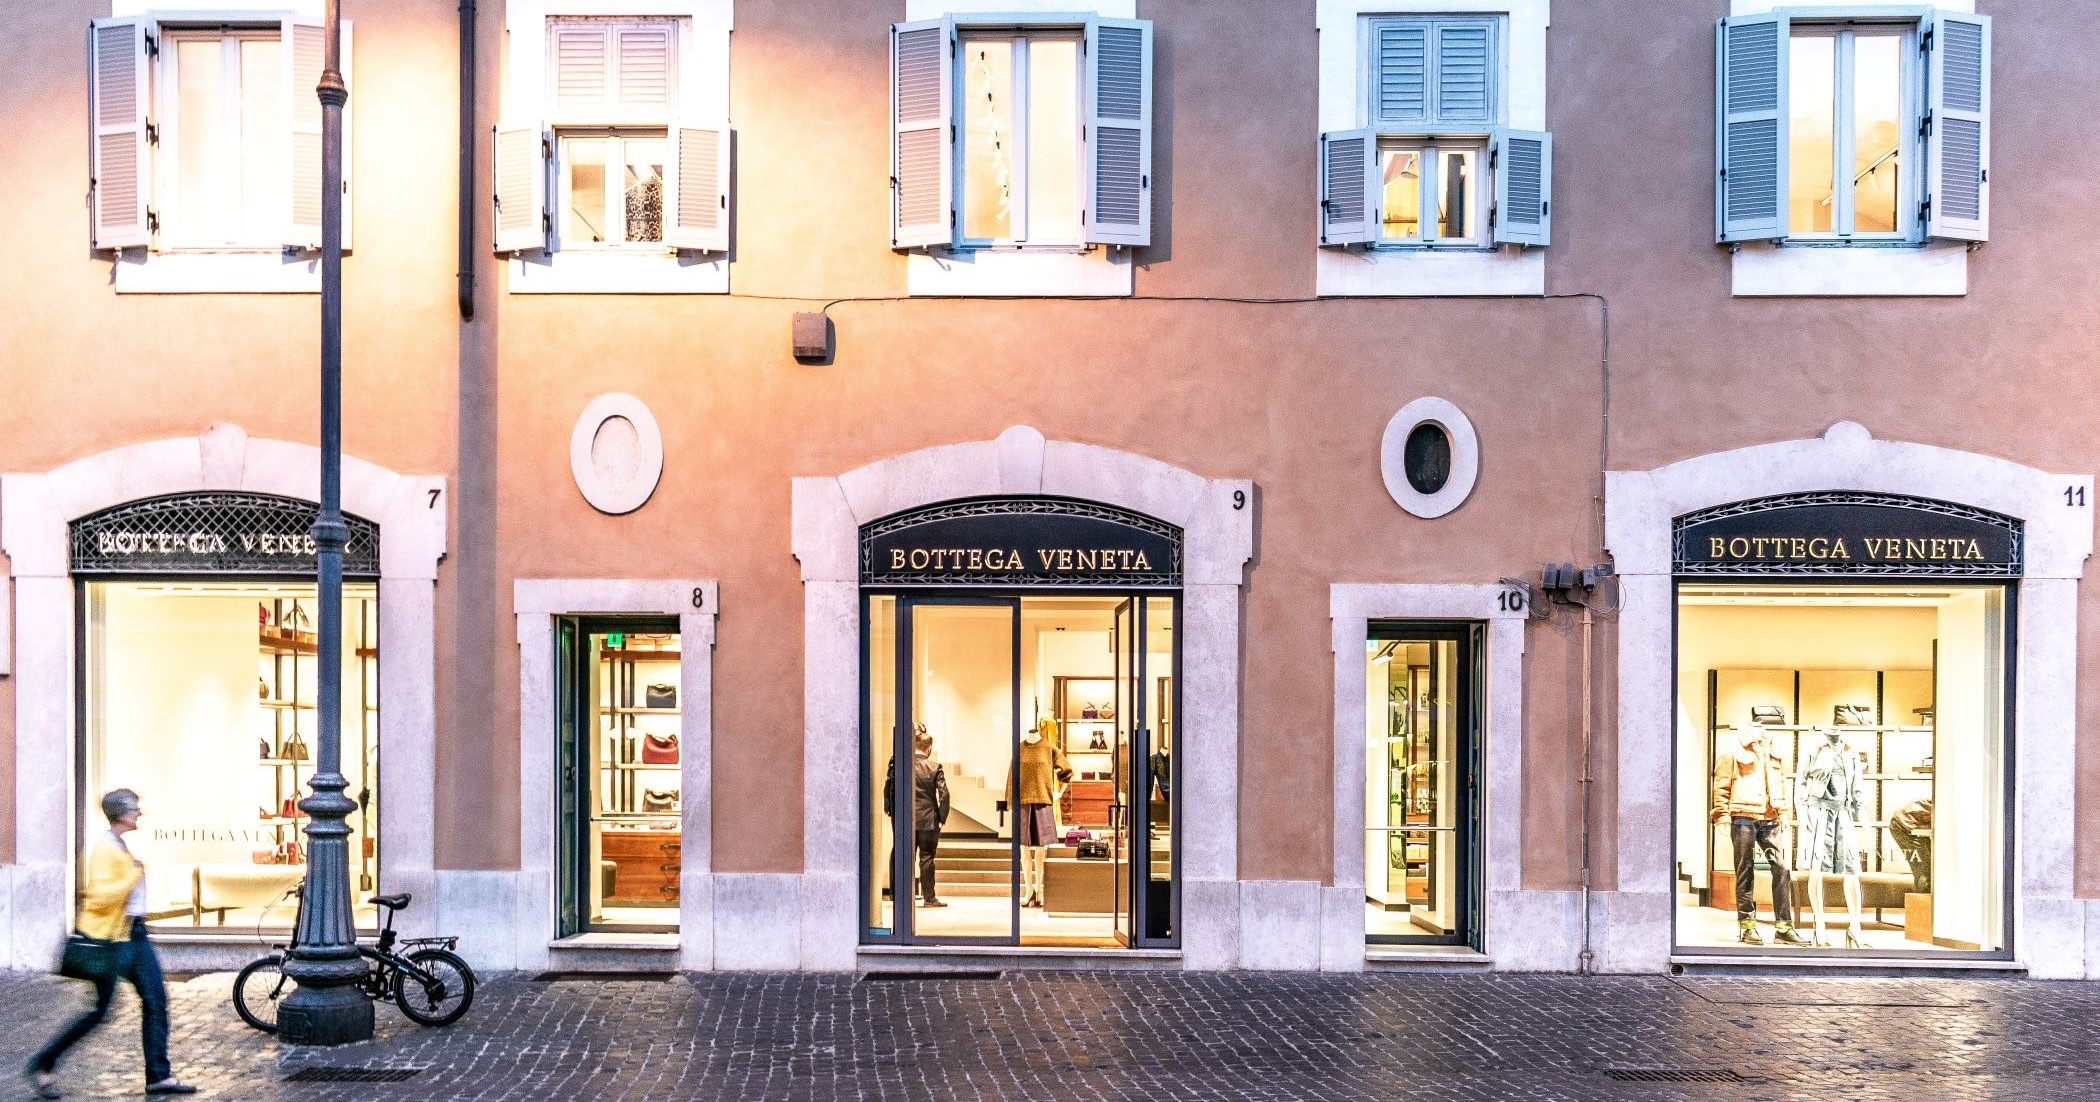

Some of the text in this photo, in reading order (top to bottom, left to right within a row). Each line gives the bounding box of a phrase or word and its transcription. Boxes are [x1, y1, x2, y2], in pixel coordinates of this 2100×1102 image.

[428, 489, 441, 509] 7
[1233, 490, 1245, 510] 9
[2064, 486, 2085, 506] 11
[98, 531, 228, 554] BOTTEGA
[1710, 537, 1984, 560] BOTTEGA VENETA
[890, 549, 1151, 570] BOTTEGA VENETA
[692, 587, 703, 608] 8
[1498, 591, 1523, 611] 10
